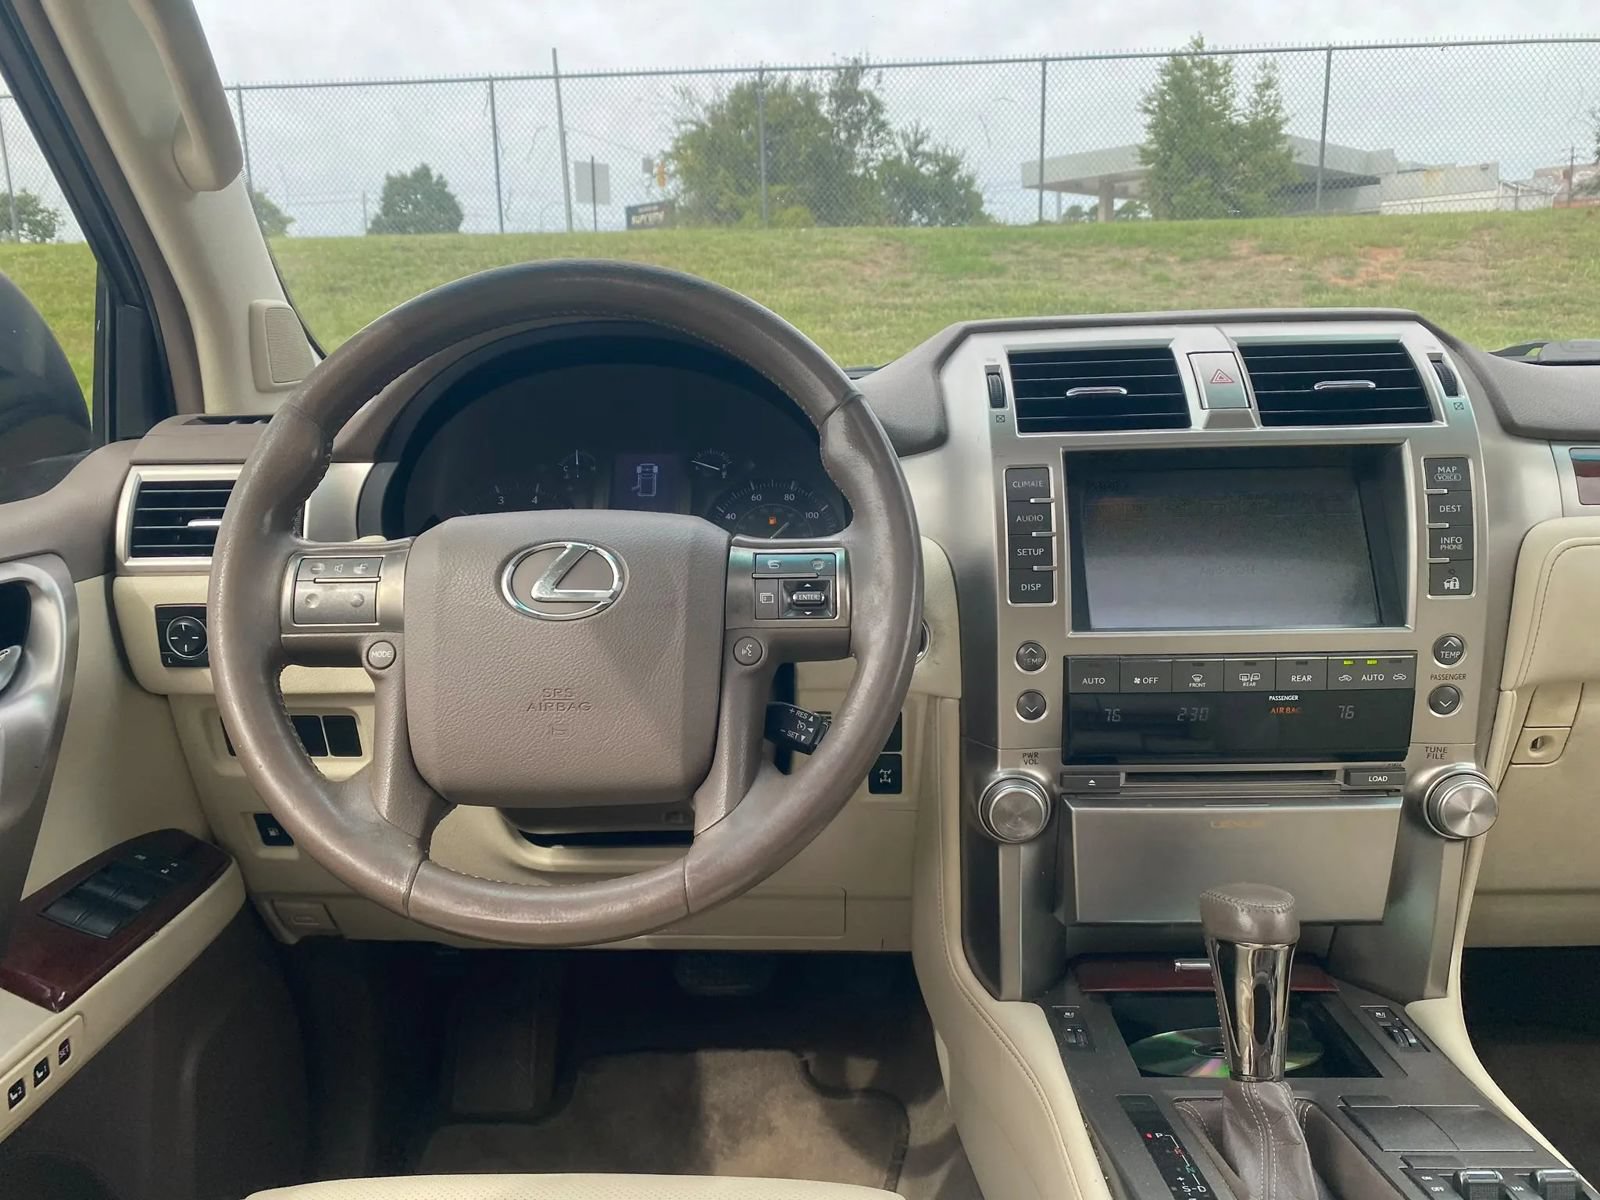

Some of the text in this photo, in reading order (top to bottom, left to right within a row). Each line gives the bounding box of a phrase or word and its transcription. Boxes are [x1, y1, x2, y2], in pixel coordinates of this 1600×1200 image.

[1437, 465, 1457, 474] MAP
[1012, 480, 1044, 489] CLIMATE
[497, 496, 505, 505] 3
[531, 495, 538, 504] 4
[751, 493, 762, 501] 60
[784, 493, 795, 501] 80
[1439, 505, 1462, 513] DEST
[725, 512, 737, 520] 40
[805, 511, 819, 519] 100
[1016, 514, 1044, 523] AUDIO
[1440, 536, 1463, 544] INFO
[1016, 547, 1045, 557] SETUP
[1020, 583, 1042, 592] DISP
[371, 650, 393, 658] MODE
[1439, 650, 1461, 660] TEMP
[1082, 677, 1106, 685] AUTO
[1142, 677, 1159, 685] OFF
[1291, 674, 1313, 682] REAR
[1361, 673, 1385, 682] AUTO
[1429, 673, 1467, 681] PASSENGER
[542, 687, 576, 699] SRS
[526, 701, 593, 712] AIRBAG
[795, 710, 809, 720] RES
[1104, 707, 1121, 723] 76
[1338, 704, 1355, 720] 76
[787, 729, 800, 739] SET
[1424, 746, 1448, 754] TUNE
[1022, 751, 1040, 759] PWR
[1024, 758, 1040, 766] VOL
